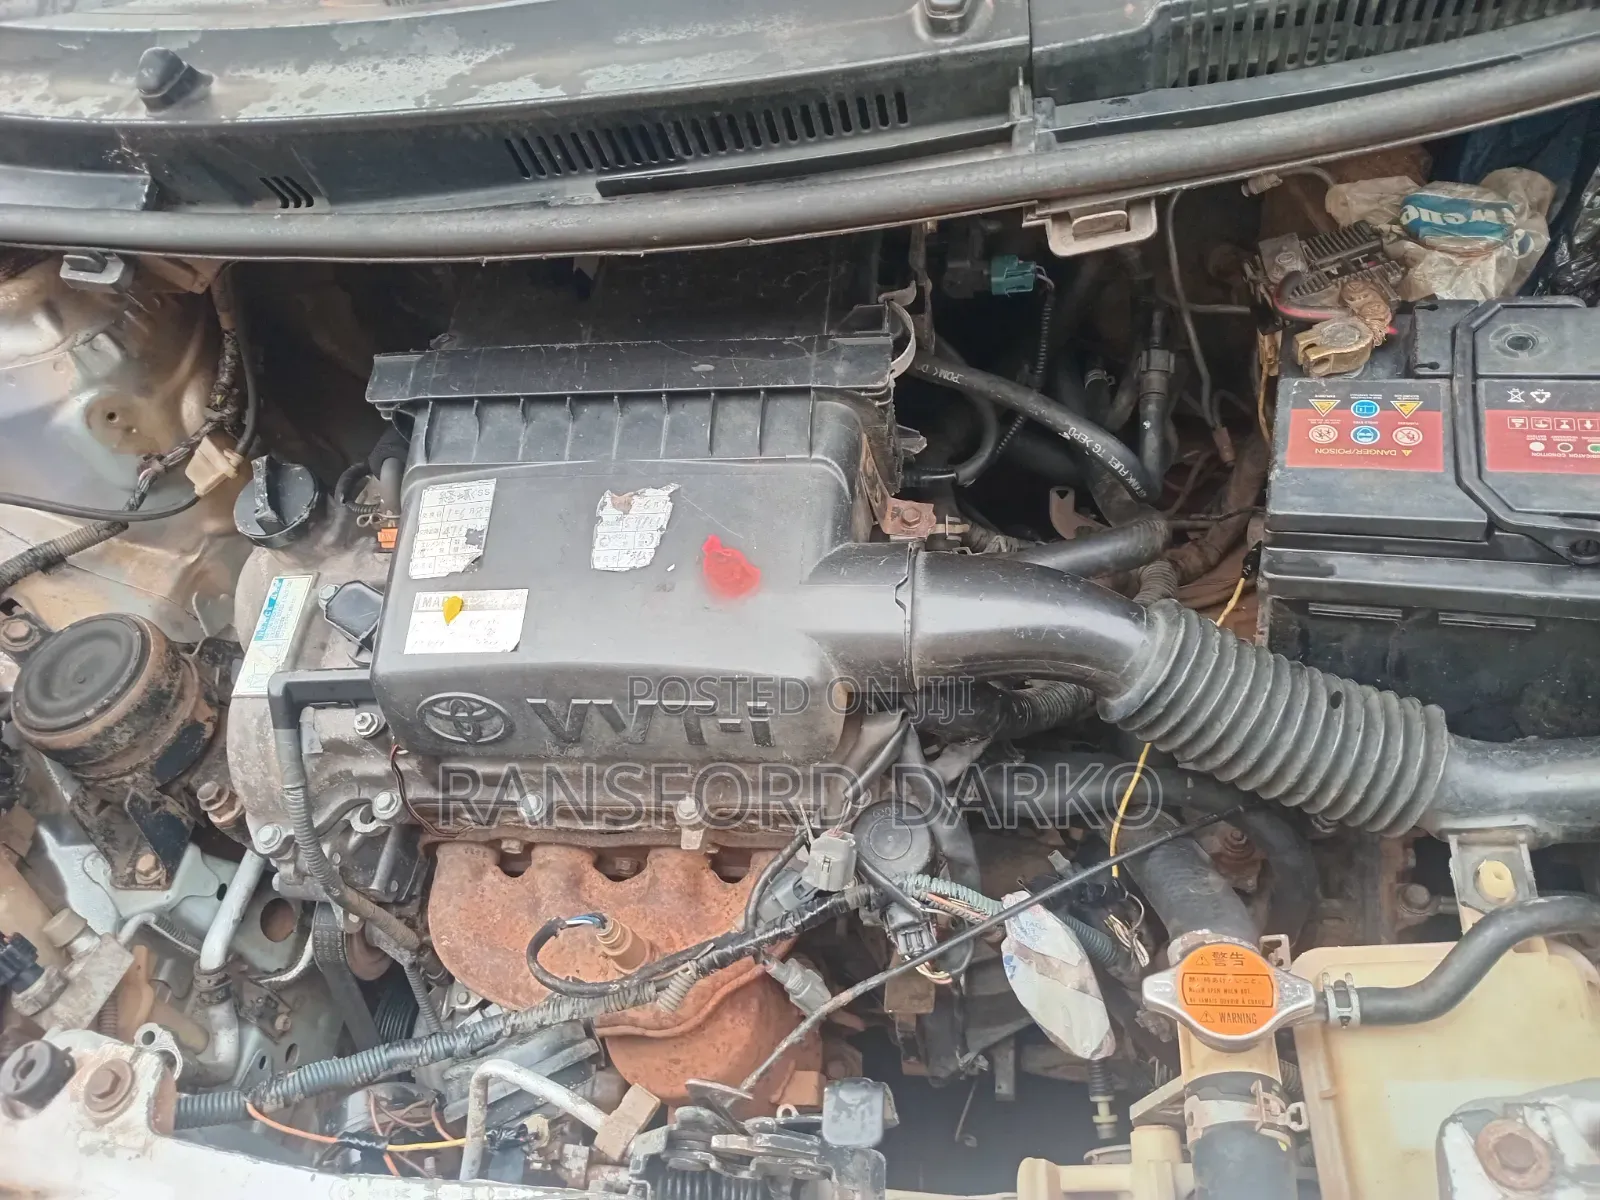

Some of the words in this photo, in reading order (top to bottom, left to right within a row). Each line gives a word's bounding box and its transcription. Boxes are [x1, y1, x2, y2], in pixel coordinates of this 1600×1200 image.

[1315, 448, 1397, 456] DANGER/POISON
[1108, 456, 1129, 477] FUEL
[526, 698, 776, 748] VVT-i
[1212, 952, 1245, 967] 警告
[1218, 1011, 1257, 1024] WARNING
